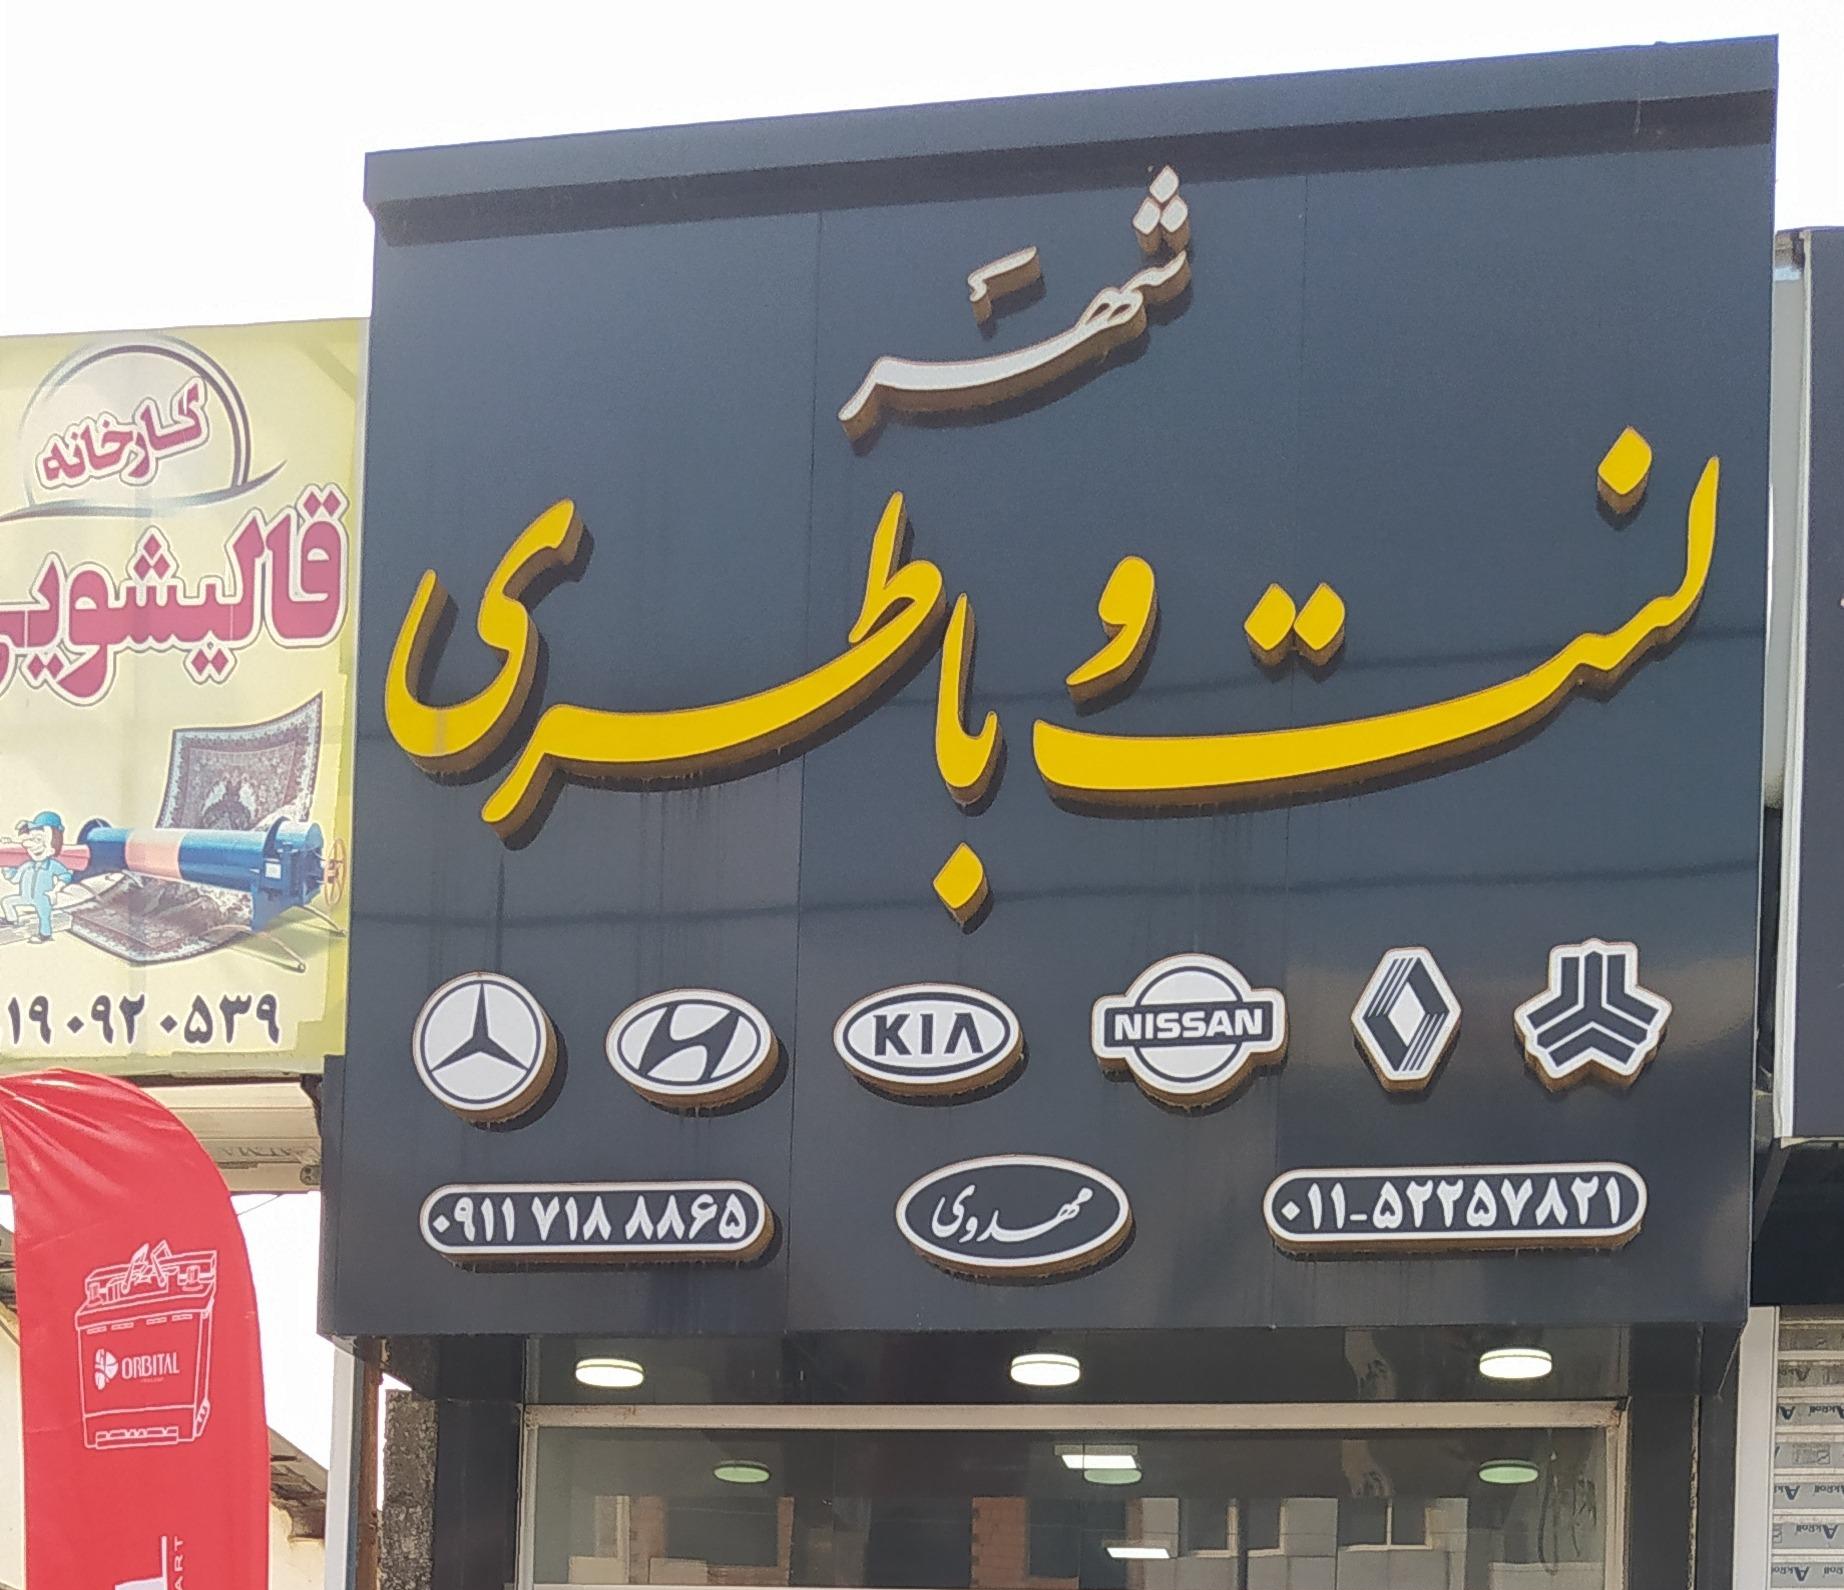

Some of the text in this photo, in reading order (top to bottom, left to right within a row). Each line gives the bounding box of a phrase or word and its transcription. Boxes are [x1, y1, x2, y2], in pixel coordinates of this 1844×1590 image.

[41, 386, 203, 486] کارخانه
[0, 490, 342, 698] قالیشوی
[385, 426, 1720, 912] لنت و باطری
[873, 1012, 984, 1057] KIA
[1114, 1008, 1263, 1040] NISSAN
[931, 1184, 1093, 1244] مهدوی
[1281, 1176, 1620, 1231] ۰۱۱-۵۲۲۵۷۸۲۱
[121, 1352, 181, 1380] ORBITAL
